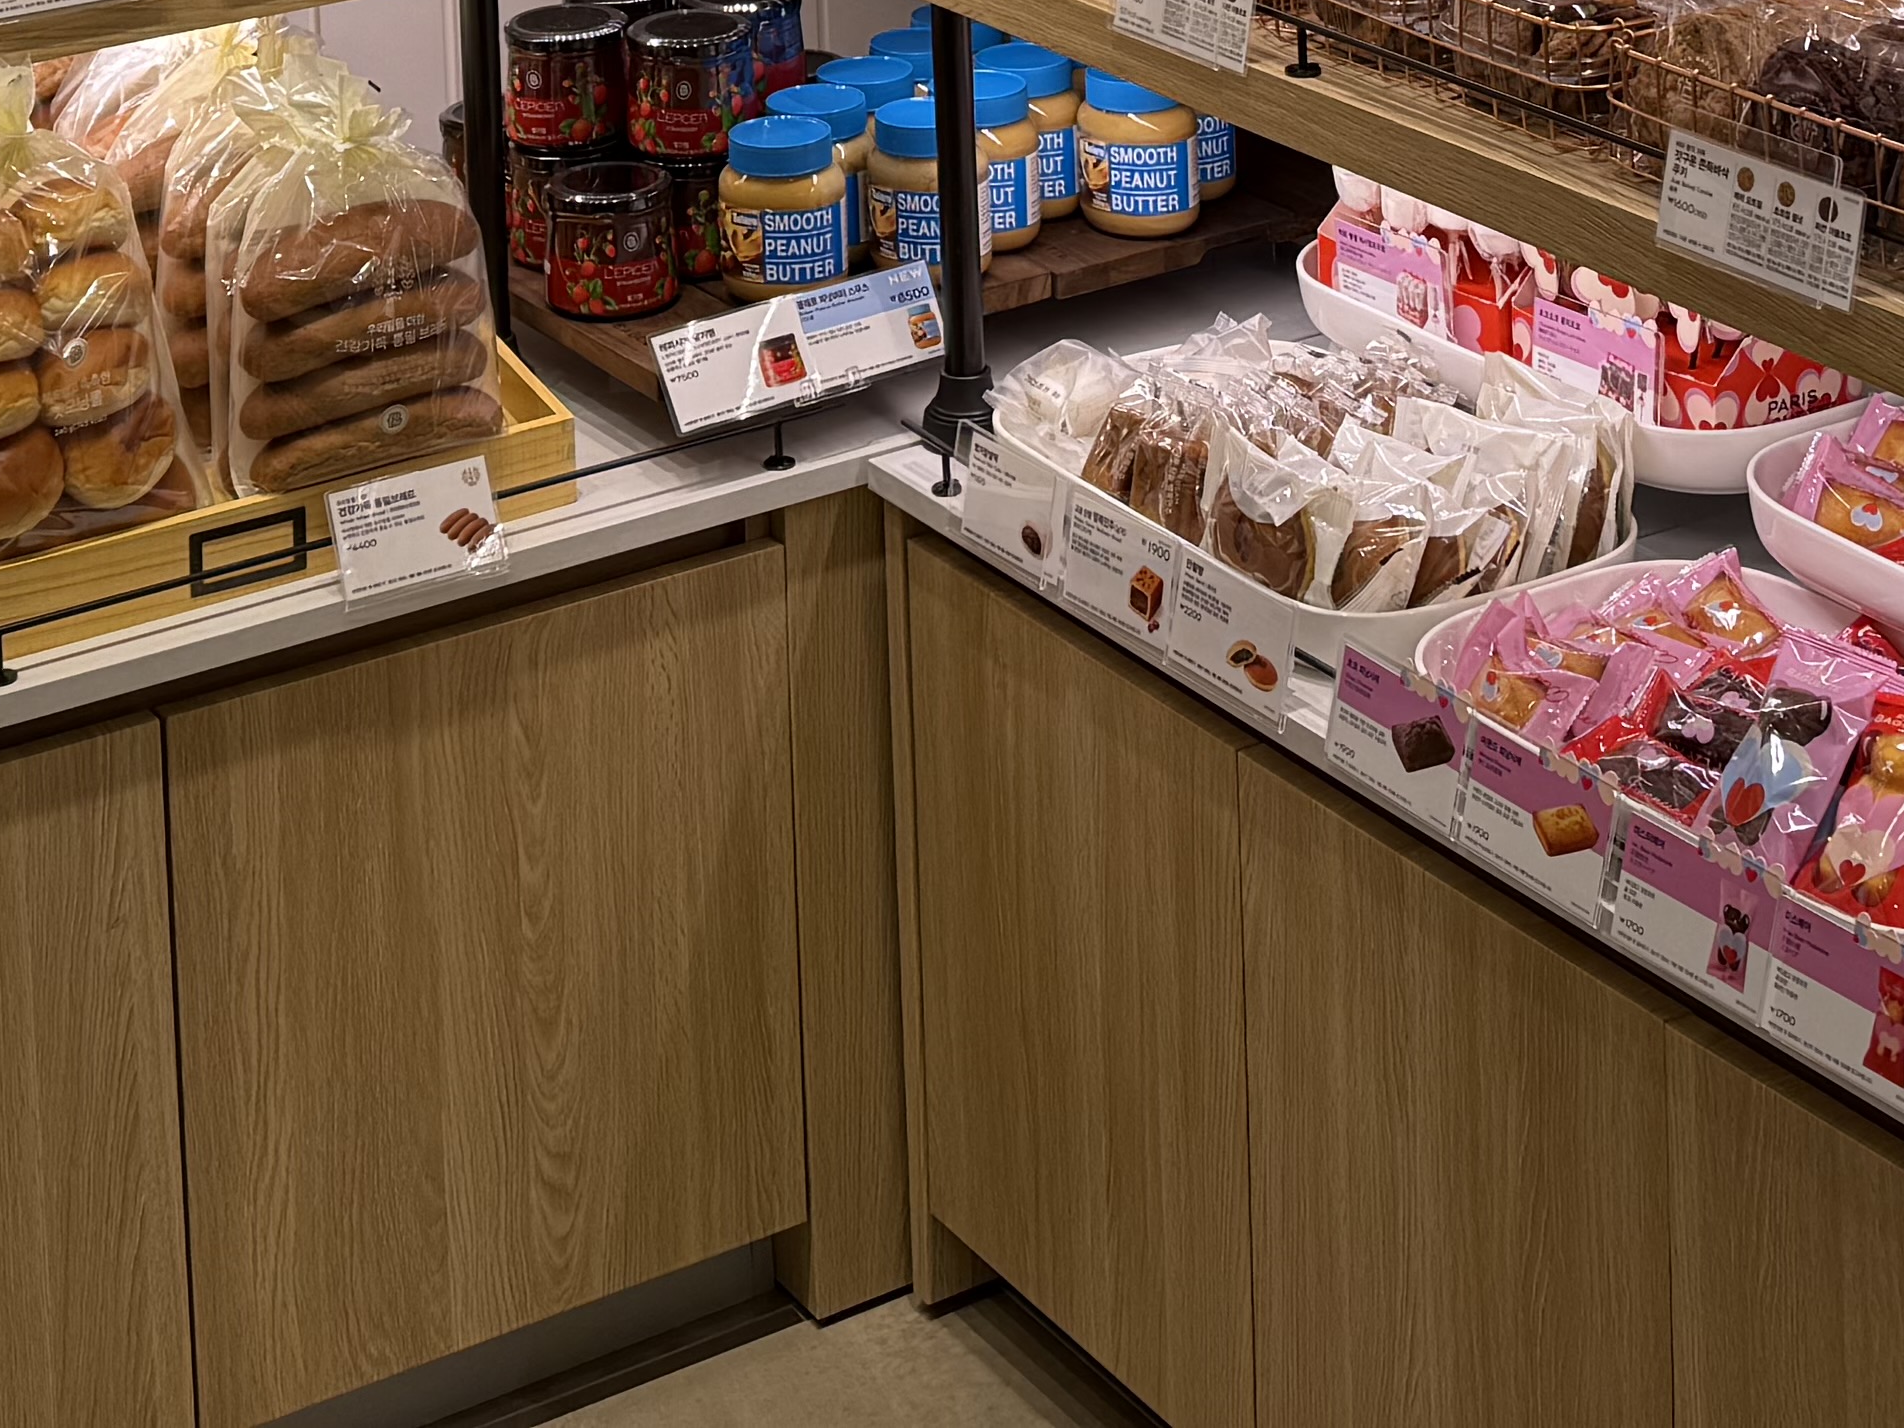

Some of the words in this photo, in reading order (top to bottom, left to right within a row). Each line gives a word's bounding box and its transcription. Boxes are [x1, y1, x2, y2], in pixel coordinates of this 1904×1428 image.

[1109, 145, 1177, 165] SMOOTH
[1110, 169, 1177, 188] PEANUT
[1111, 193, 1180, 213] BUTTER
[764, 209, 833, 232] SMOOTH
[765, 234, 834, 257] PEANUT
[766, 260, 835, 284] BUTTER
[888, 267, 922, 285] NEW
[1767, 389, 1819, 417] PARIS
